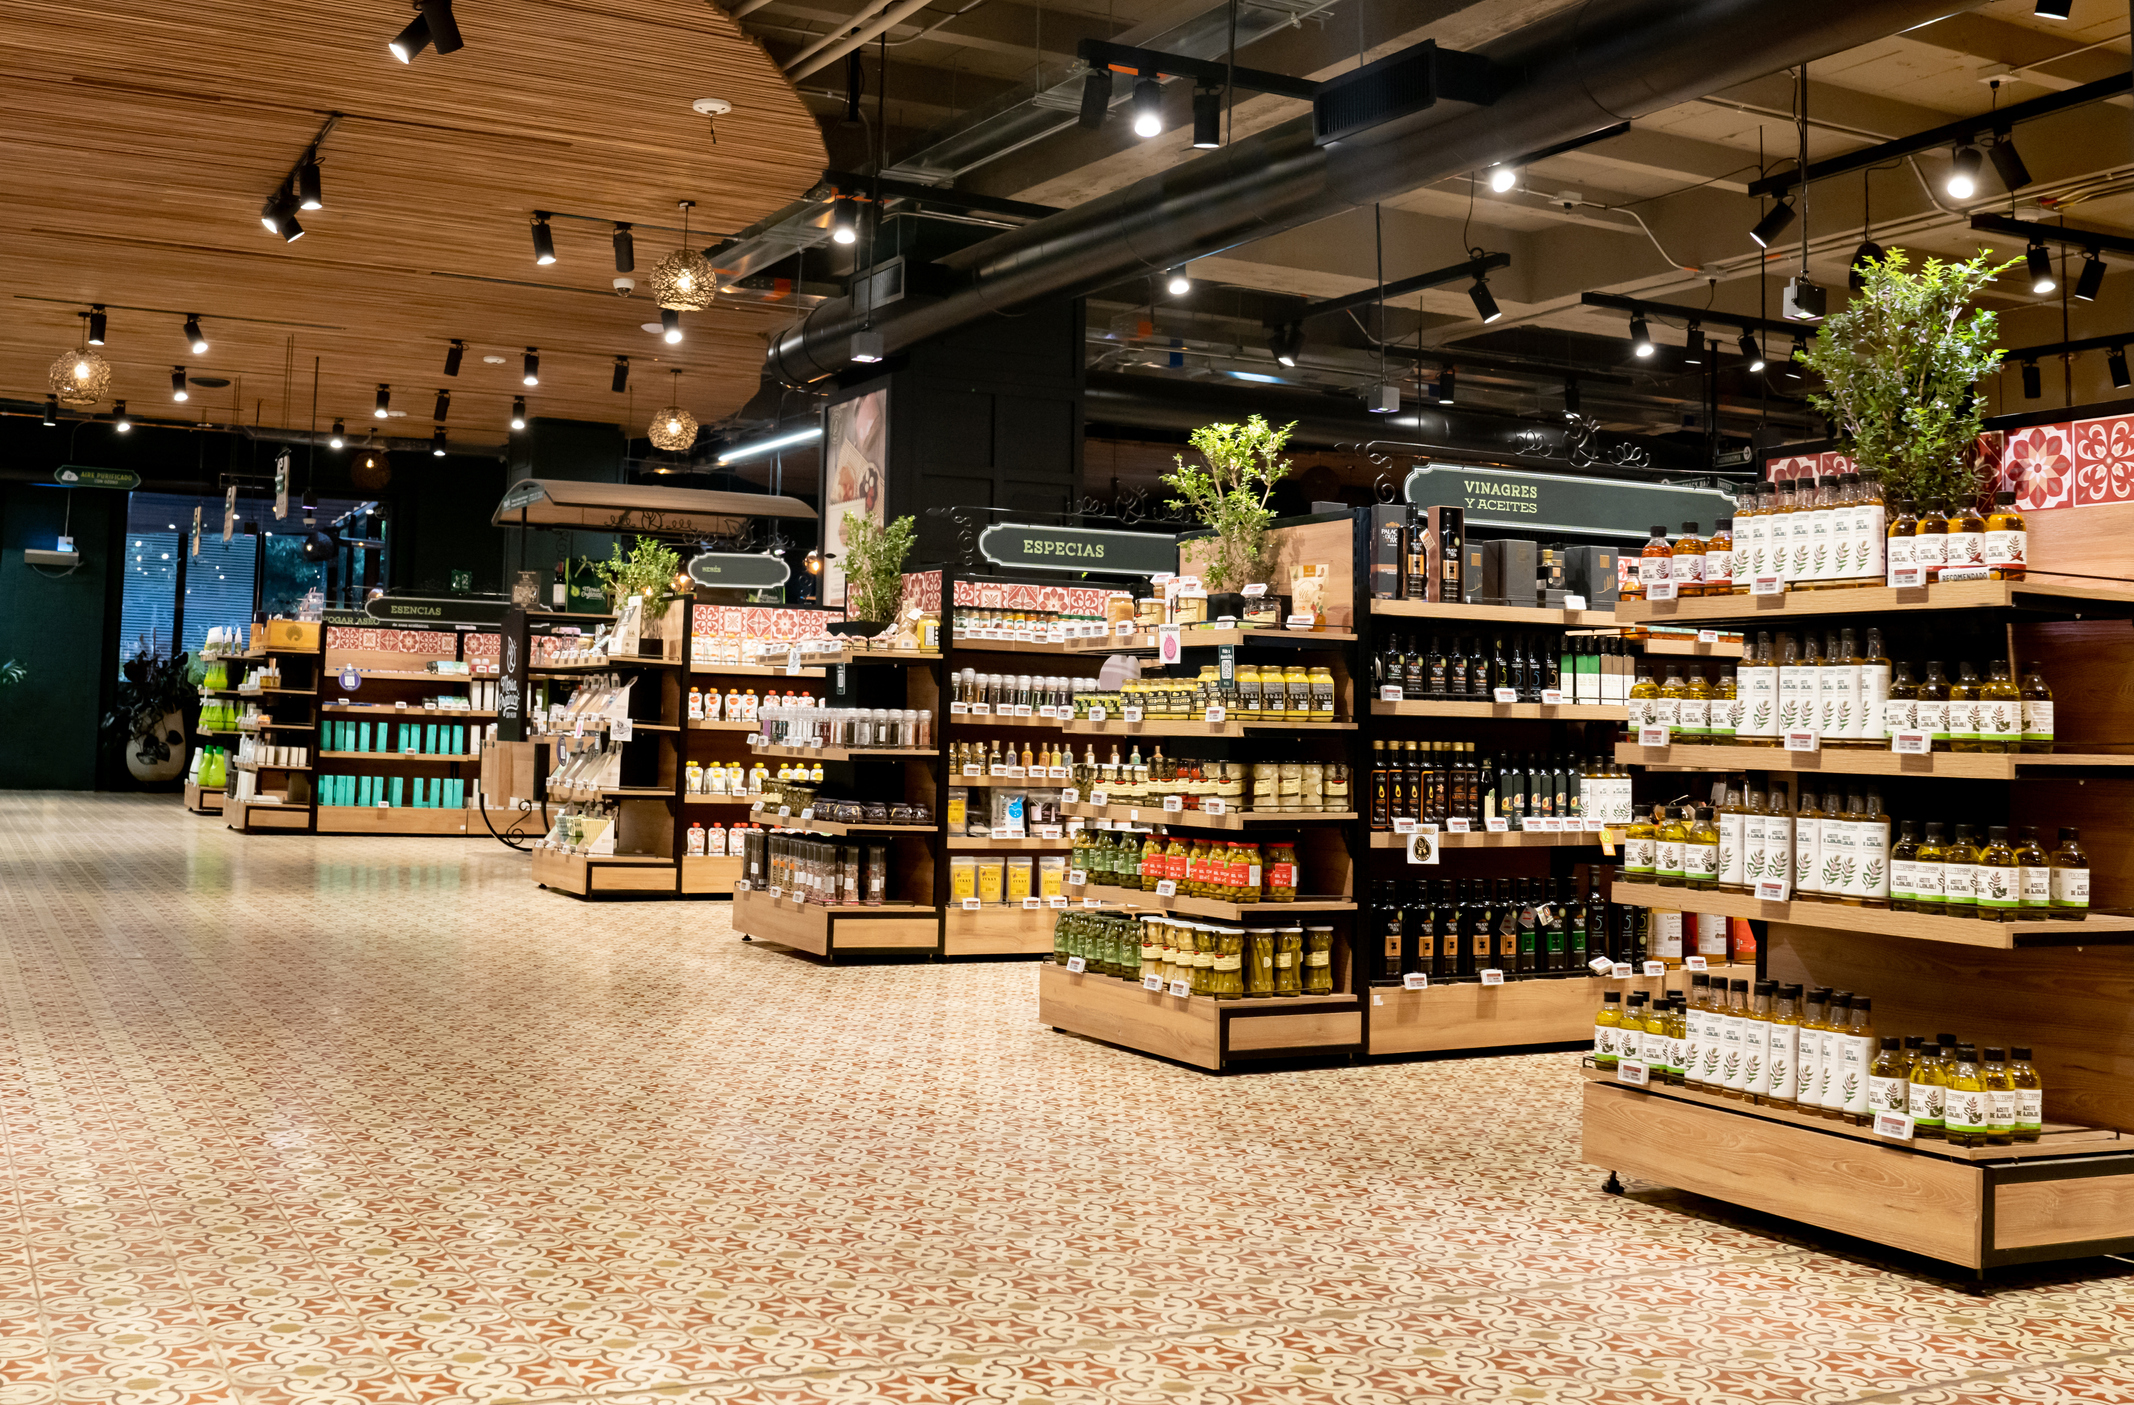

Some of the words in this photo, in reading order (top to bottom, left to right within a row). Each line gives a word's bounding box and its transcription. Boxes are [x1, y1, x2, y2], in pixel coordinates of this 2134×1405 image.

[97, 473, 133, 482] PURIFICADO
[1464, 480, 1538, 499] VINAGRES
[1465, 498, 1475, 510] Y
[1477, 499, 1538, 514] ACEITES
[1023, 539, 1105, 558] ESPECIAS
[1942, 571, 1988, 582] RECOMENDADO
[390, 605, 442, 616] ESENCIAS
[1594, 914, 1603, 930] 5
[1623, 914, 1632, 930] 5
[1638, 913, 1647, 928] 5
